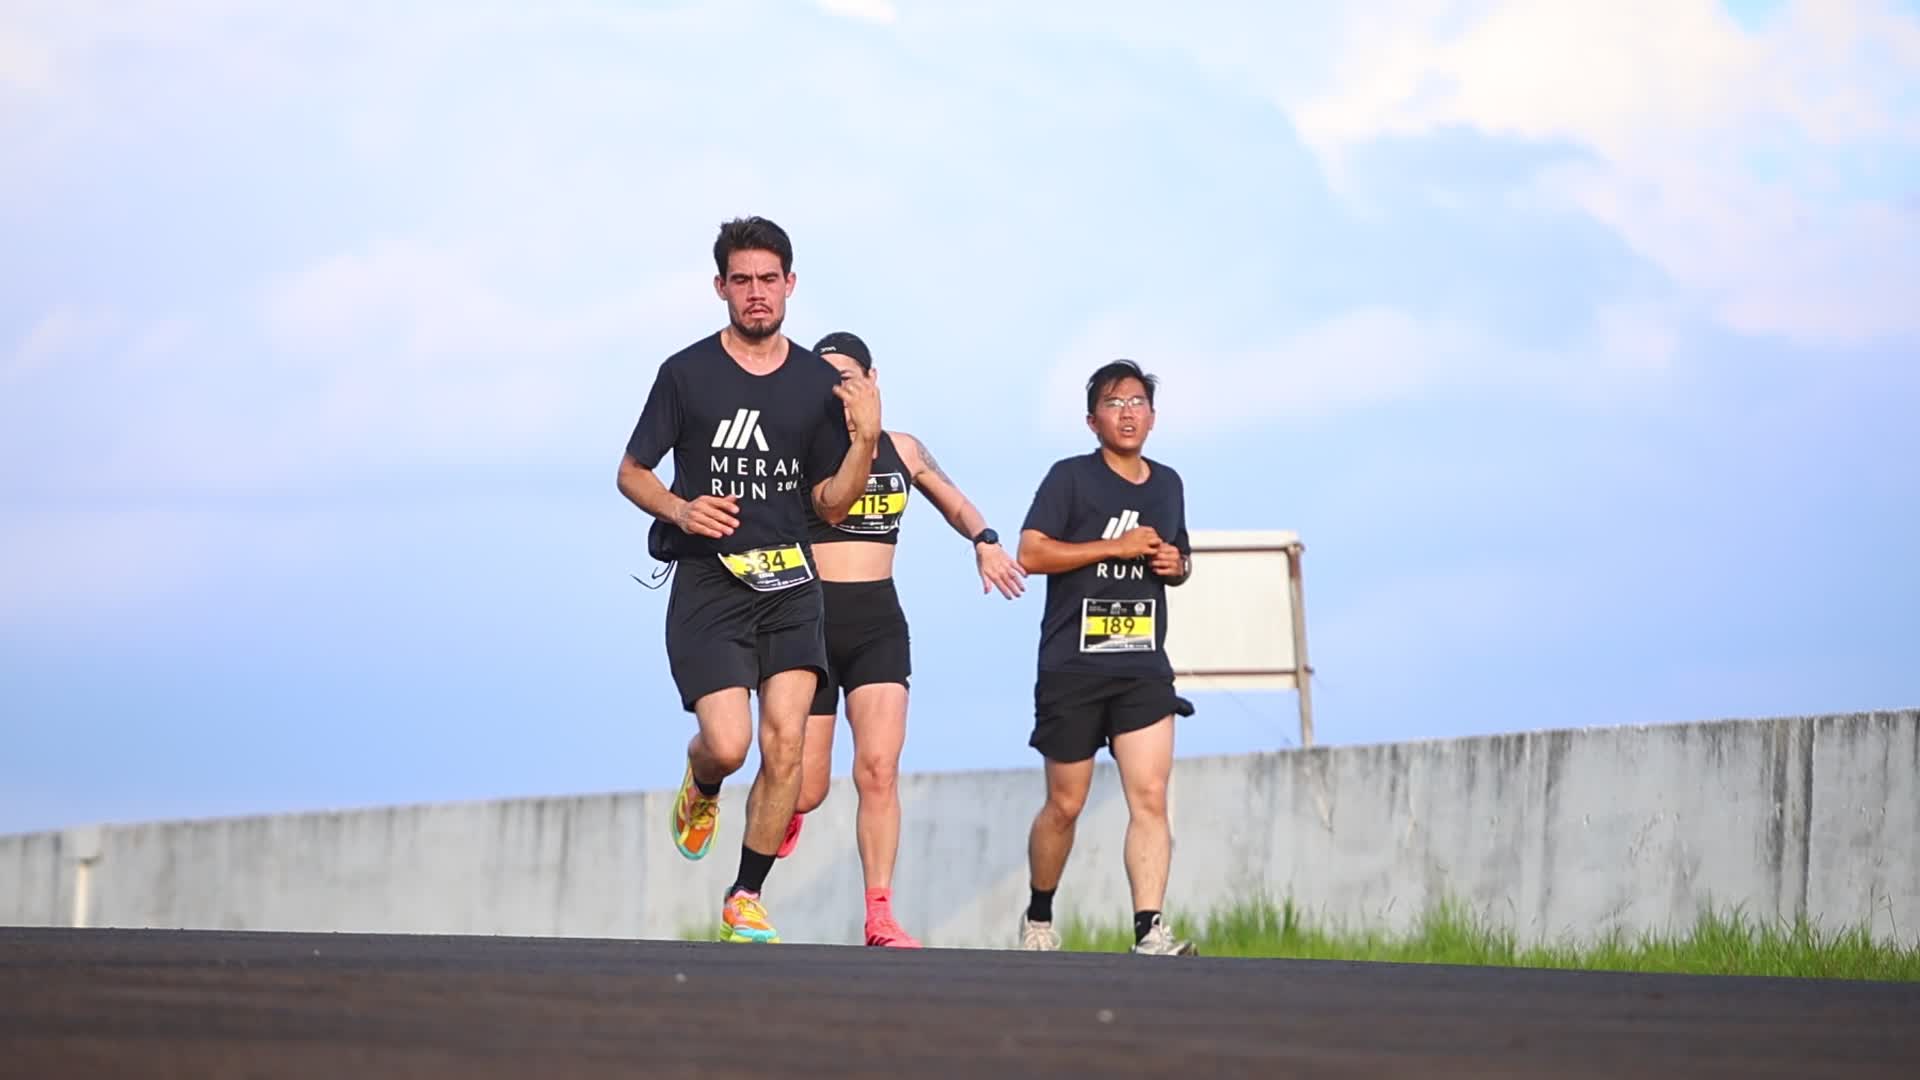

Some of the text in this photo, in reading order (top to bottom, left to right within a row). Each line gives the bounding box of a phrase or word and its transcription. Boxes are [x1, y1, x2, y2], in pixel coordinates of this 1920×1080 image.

[711, 455, 799, 477] MERAK
[711, 478, 766, 500] RUN
[861, 495, 889, 514] 115
[1096, 562, 1144, 580] RUN
[1102, 616, 1135, 634] 189
